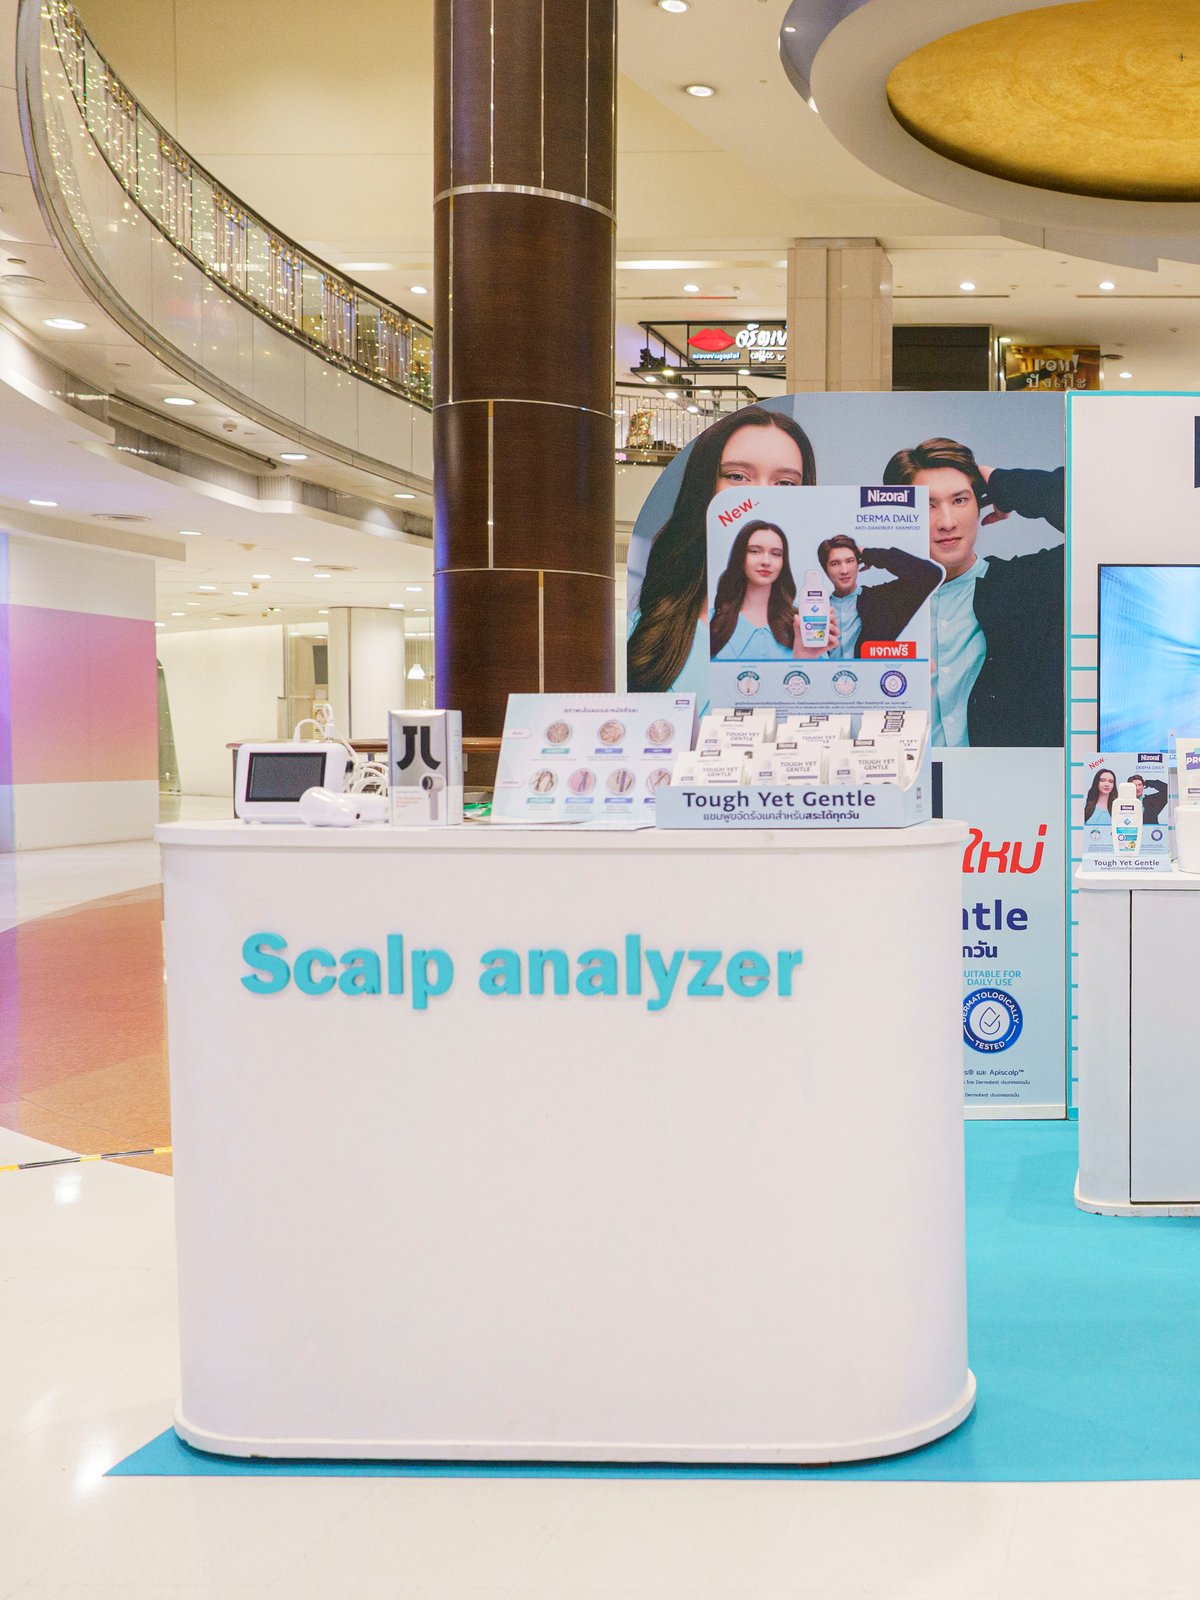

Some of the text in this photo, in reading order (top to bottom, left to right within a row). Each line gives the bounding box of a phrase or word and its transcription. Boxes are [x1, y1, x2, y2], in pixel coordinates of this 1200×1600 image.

[856, 514, 920, 523] DERMA DAILY
[869, 643, 909, 657] แจกฟรี
[682, 790, 876, 811] Tough Yet Gentle
[962, 824, 1048, 874] ใหม่
[1094, 859, 1117, 867] Tough
[962, 940, 998, 958] กวัน
[240, 932, 804, 1011] Scalp analyzer
[963, 970, 1022, 978] UITABLE FOR
[974, 1041, 1005, 1051] TESTED
